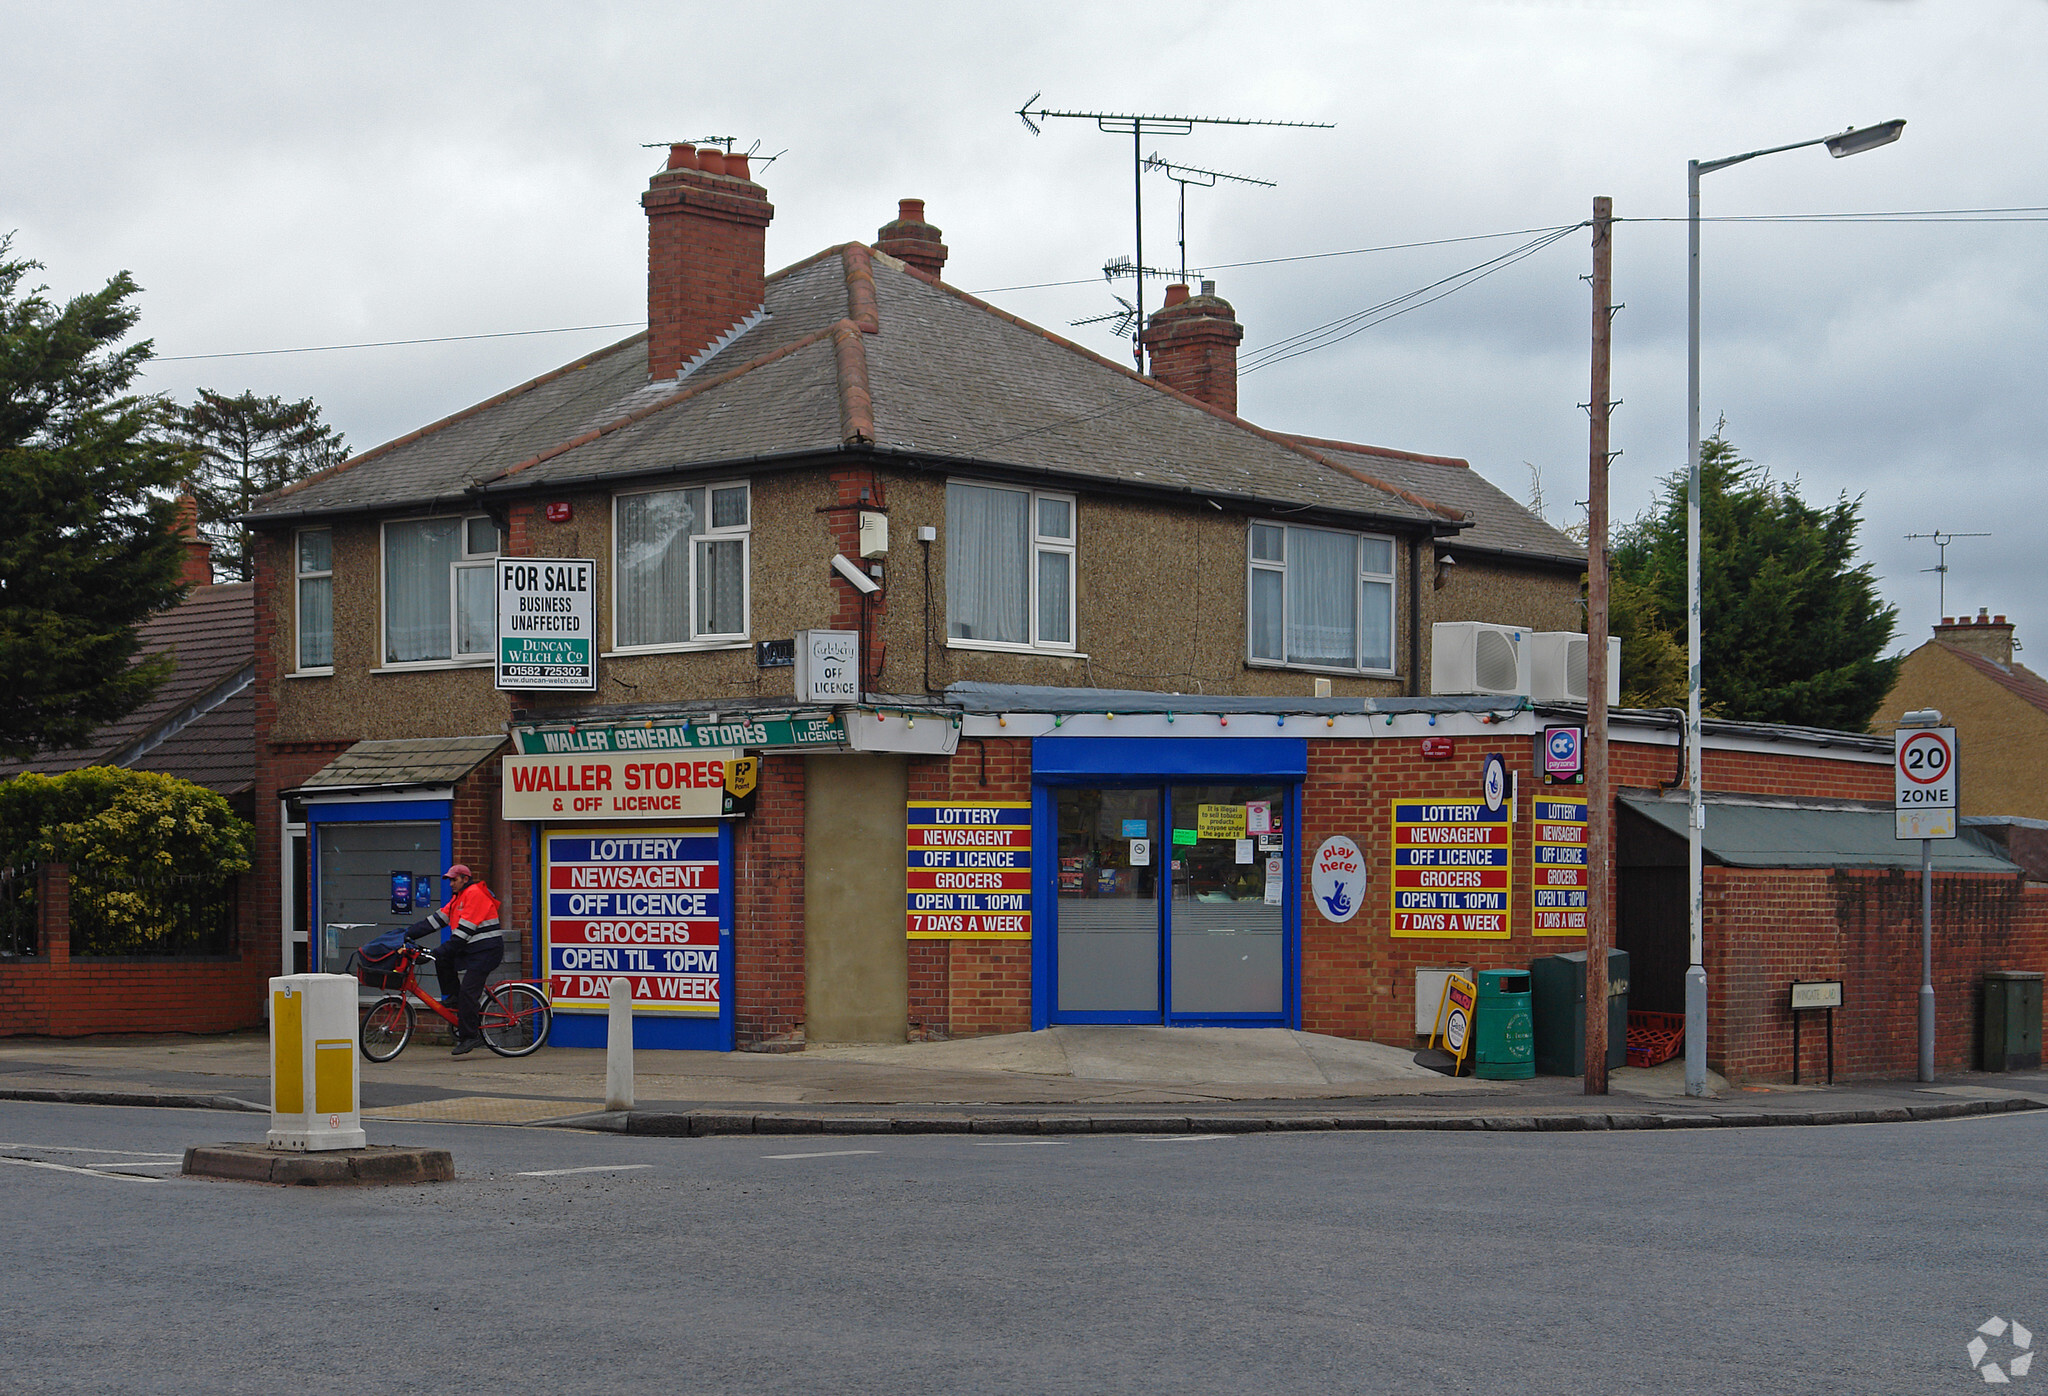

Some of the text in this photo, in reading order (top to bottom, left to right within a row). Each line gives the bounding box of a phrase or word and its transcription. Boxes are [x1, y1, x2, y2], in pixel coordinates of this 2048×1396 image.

[504, 566, 587, 592] FOR SALE
[520, 596, 572, 612] BUSINESS
[511, 615, 580, 631] UNAFFECTED
[555, 653, 562, 663] &
[509, 666, 582, 676] 01582 725302
[824, 668, 842, 679] OFF
[815, 682, 854, 694] LICENCE
[808, 721, 829, 731] OFF
[543, 723, 768, 752] WALLER GENERAL STORES
[797, 729, 845, 742] LICENCE
[1909, 747, 1944, 769] 20
[512, 760, 724, 792] WALLER STORES
[1902, 789, 1948, 802] ZONE
[553, 796, 681, 812] & OFF LICENCE
[1548, 804, 1576, 819] LOTTERY
[936, 809, 1000, 824] LOTTERY
[1422, 806, 1480, 822] LOTTERY
[924, 830, 1013, 845] NEWSAGENT
[1411, 828, 1492, 843] NEWSAGENT
[1543, 826, 1581, 842] NEWSAGENT
[590, 839, 682, 860] LOTTERY
[1323, 845, 1354, 860] play
[1410, 849, 1492, 865] OFF LICENCE
[1542, 847, 1582, 863] OFF LICENCE
[924, 851, 1014, 867] OFF LICENCE
[1320, 861, 1358, 873] here!
[571, 867, 704, 887] NEWSAGENT
[935, 873, 1002, 889] GROCERS
[1420, 871, 1482, 887] GROCERS
[1548, 869, 1577, 885] GROCERS
[569, 895, 706, 915] OFF LICENCE
[916, 894, 1022, 910] OPEN TIL 10PM
[1402, 892, 1498, 909] OPEN TIL 10PM
[1538, 891, 1555, 906] OPEN
[1557, 891, 1567, 906] TIL
[913, 916, 1024, 931] 7 DAYS A WEEK
[1400, 914, 1500, 931] 7 DAYS A WEEK
[1538, 913, 1585, 928] 7 DAYS A WEEK
[584, 922, 690, 943] GROCERS
[562, 949, 717, 972] OPEN TIL 10PM
[285, 986, 291, 997] 3
[560, 977, 720, 999] 7 DAY A WEEK
